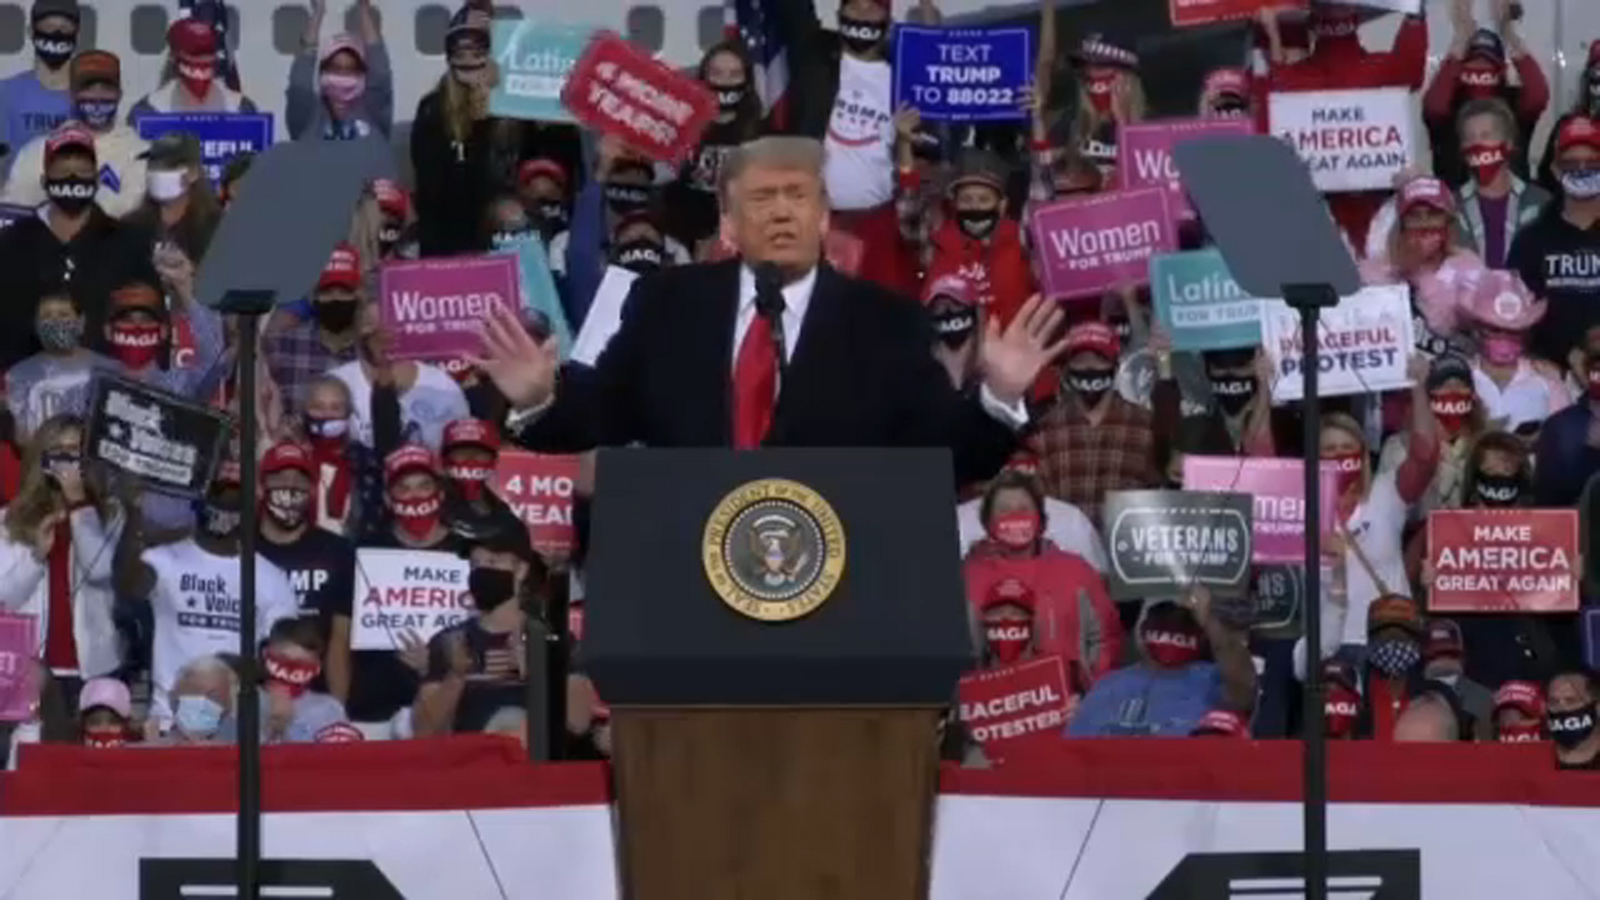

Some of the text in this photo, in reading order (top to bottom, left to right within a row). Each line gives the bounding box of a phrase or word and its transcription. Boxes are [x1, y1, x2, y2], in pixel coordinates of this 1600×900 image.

[937, 44, 992, 62] TEXT
[926, 65, 1002, 83] TRUMP
[912, 86, 1013, 105] TO 88022
[1311, 107, 1365, 123] MAKE
[1346, 152, 1407, 170] AGAIN
[1051, 219, 1161, 260] Women
[392, 291, 502, 321] Women
[505, 474, 573, 497] 4 MO
[1131, 525, 1239, 553] VETERANS
[1473, 525, 1532, 542] MAKE
[1436, 546, 1570, 569] AMERICA
[179, 572, 226, 594] Black
[403, 566, 461, 583] MAKE
[1436, 575, 1571, 592] GREAT AGAIN
[204, 594, 241, 613] Voic
[363, 587, 476, 609] AMERIC
[361, 614, 426, 629] GREAT
[960, 685, 1060, 721] EACEFUL
